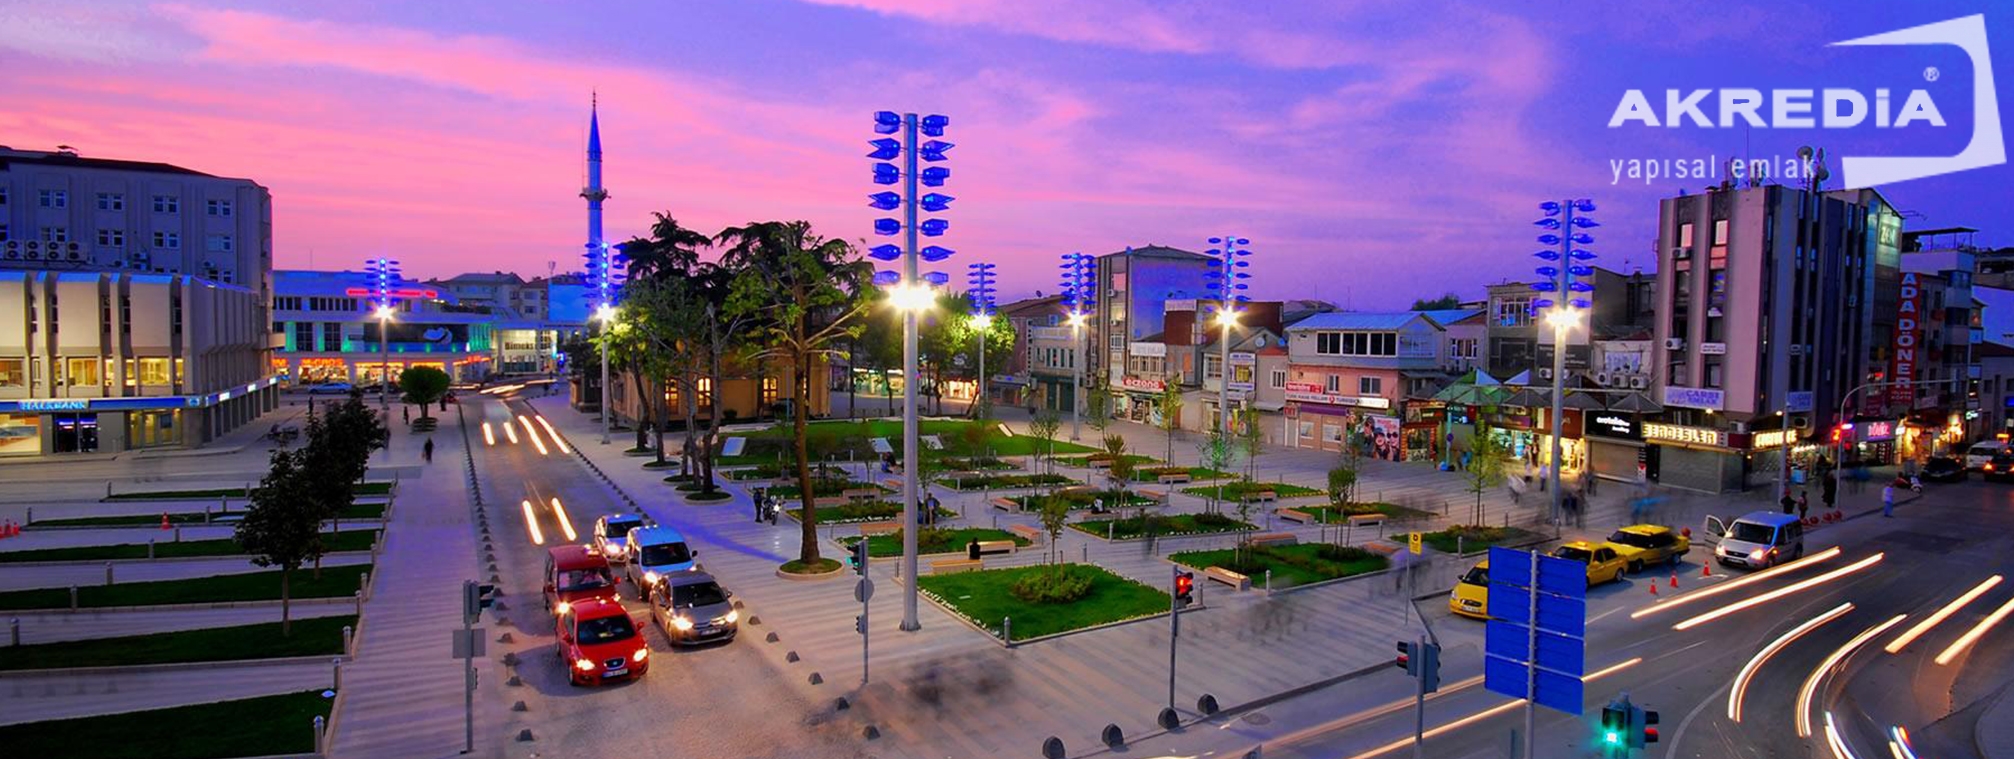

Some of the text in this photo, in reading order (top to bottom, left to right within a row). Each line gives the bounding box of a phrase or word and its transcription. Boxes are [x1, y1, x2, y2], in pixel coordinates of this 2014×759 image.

[1895, 272, 1918, 389] ADA DÖNER
[20, 400, 86, 410] HALKBANK
